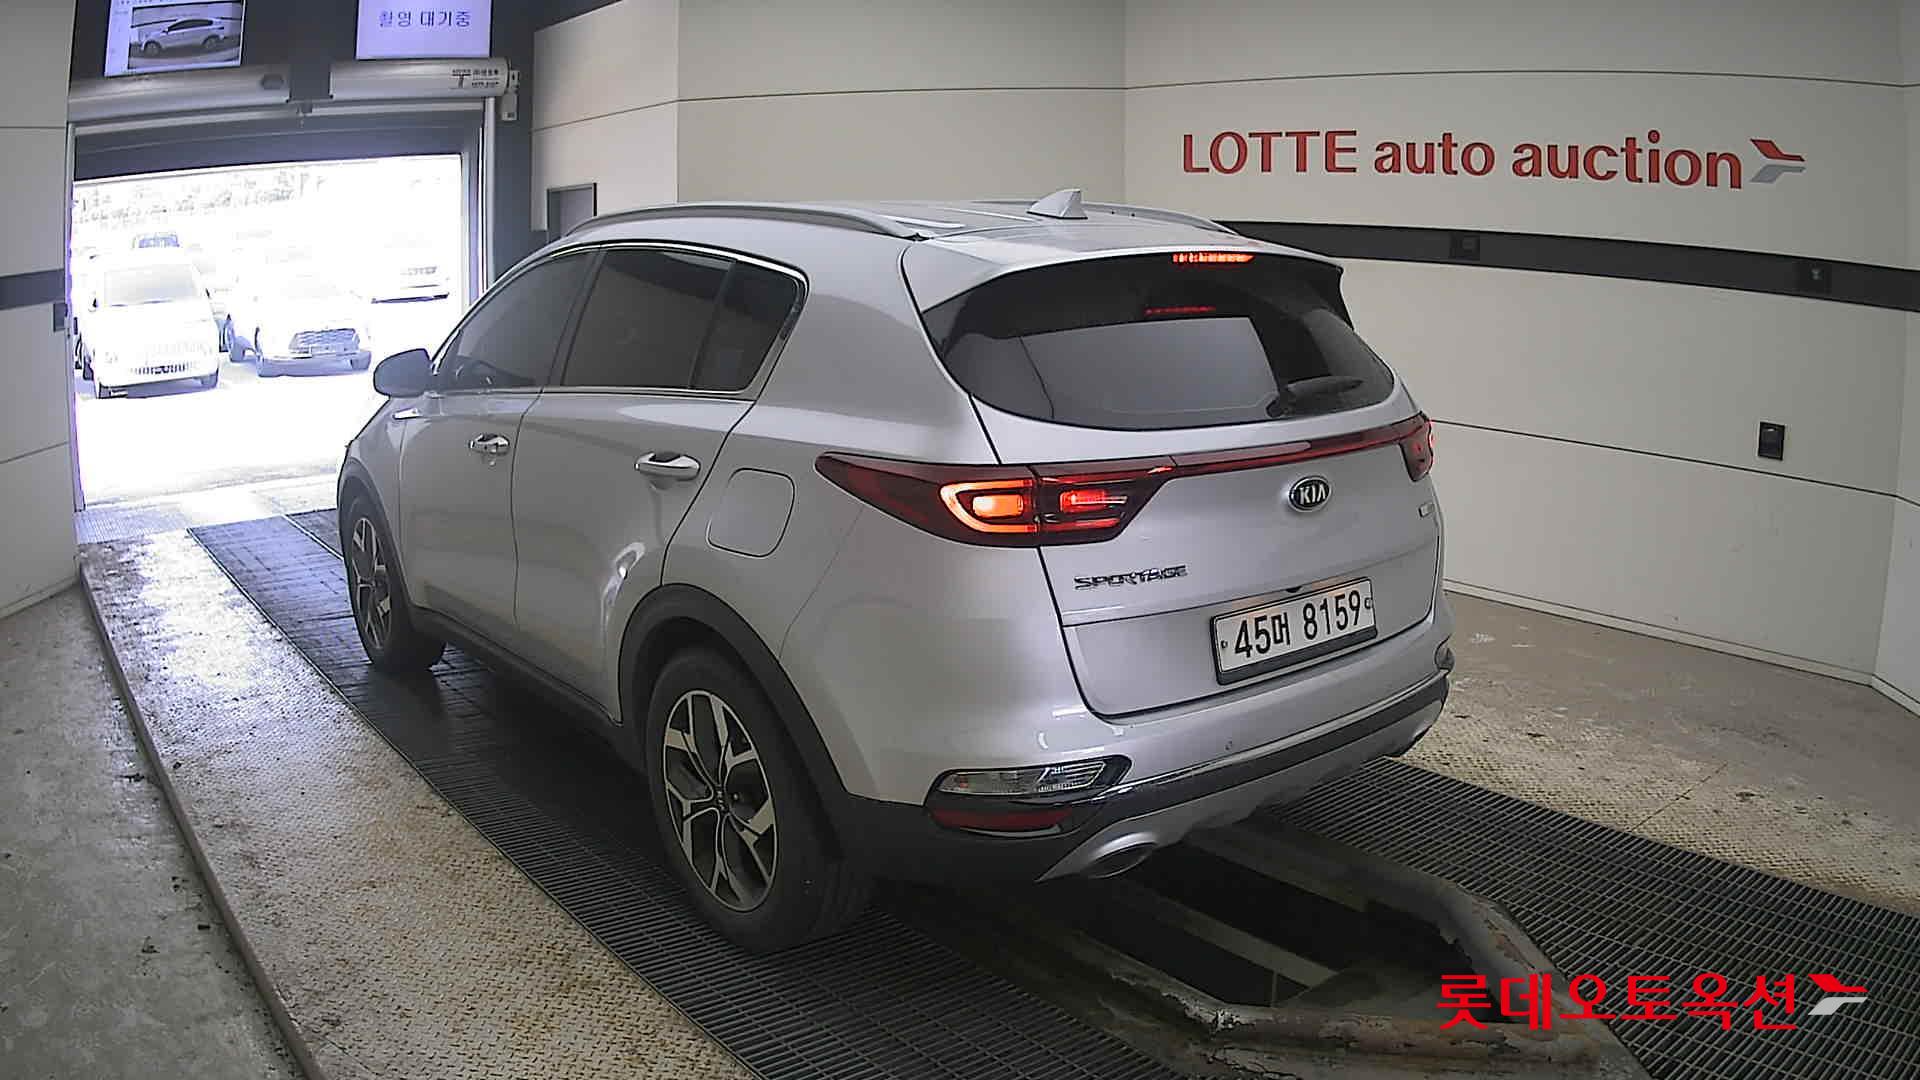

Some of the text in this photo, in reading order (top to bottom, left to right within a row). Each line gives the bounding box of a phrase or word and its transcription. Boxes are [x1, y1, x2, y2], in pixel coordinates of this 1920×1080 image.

[420, 11, 470, 27] 대기중
[1183, 130, 1743, 189] LOTTE auto auction
[1299, 484, 1326, 504] KIA
[1073, 565, 1188, 591] SPORTAGE
[1234, 590, 1361, 658] 45머 8159
